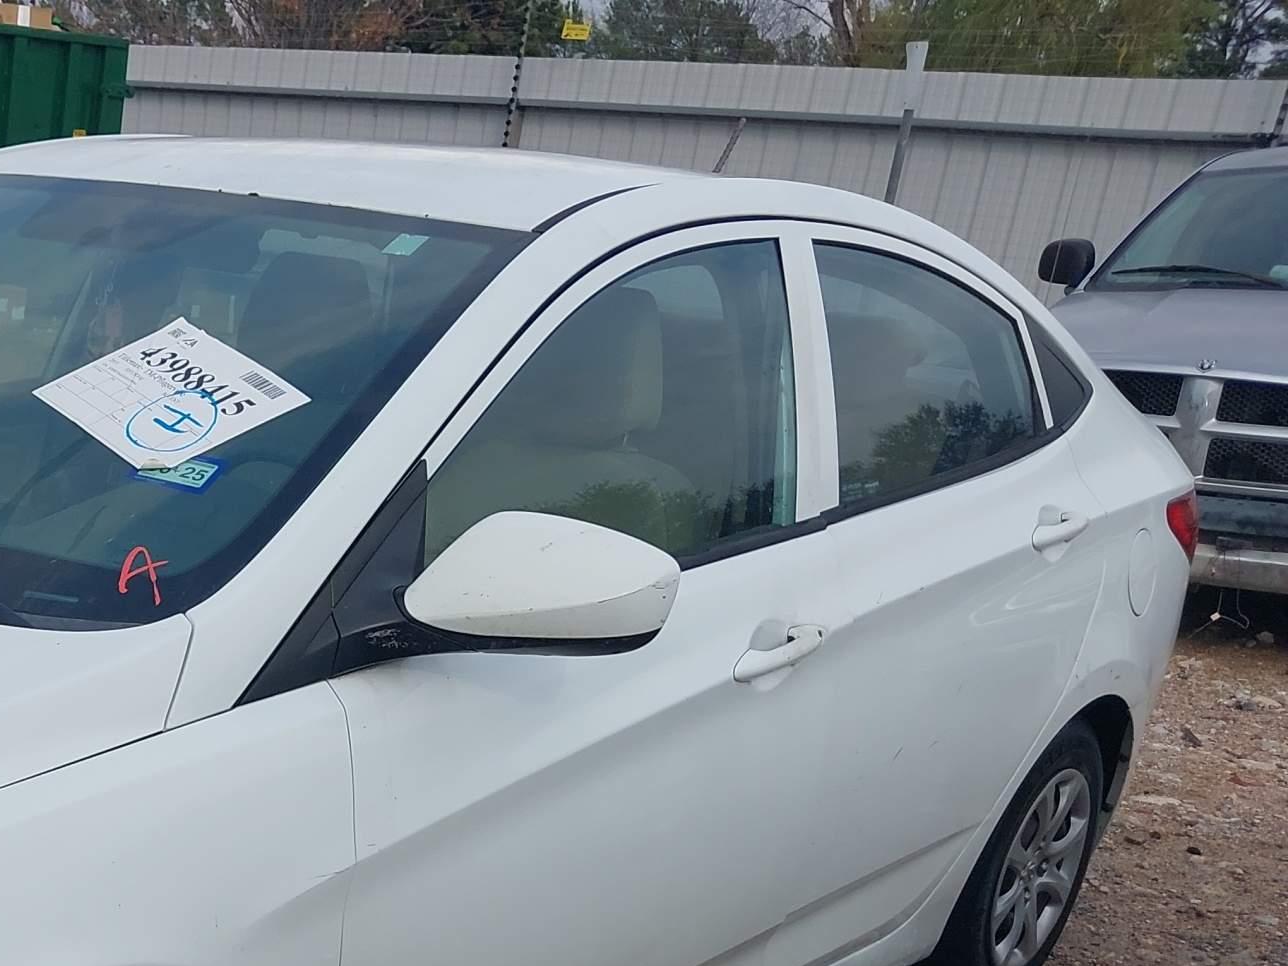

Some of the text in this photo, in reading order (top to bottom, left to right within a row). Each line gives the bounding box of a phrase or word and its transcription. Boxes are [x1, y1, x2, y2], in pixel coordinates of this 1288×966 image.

[139, 346, 257, 416] 43988415
[179, 466, 209, 481] 25
[118, 546, 169, 606] A
